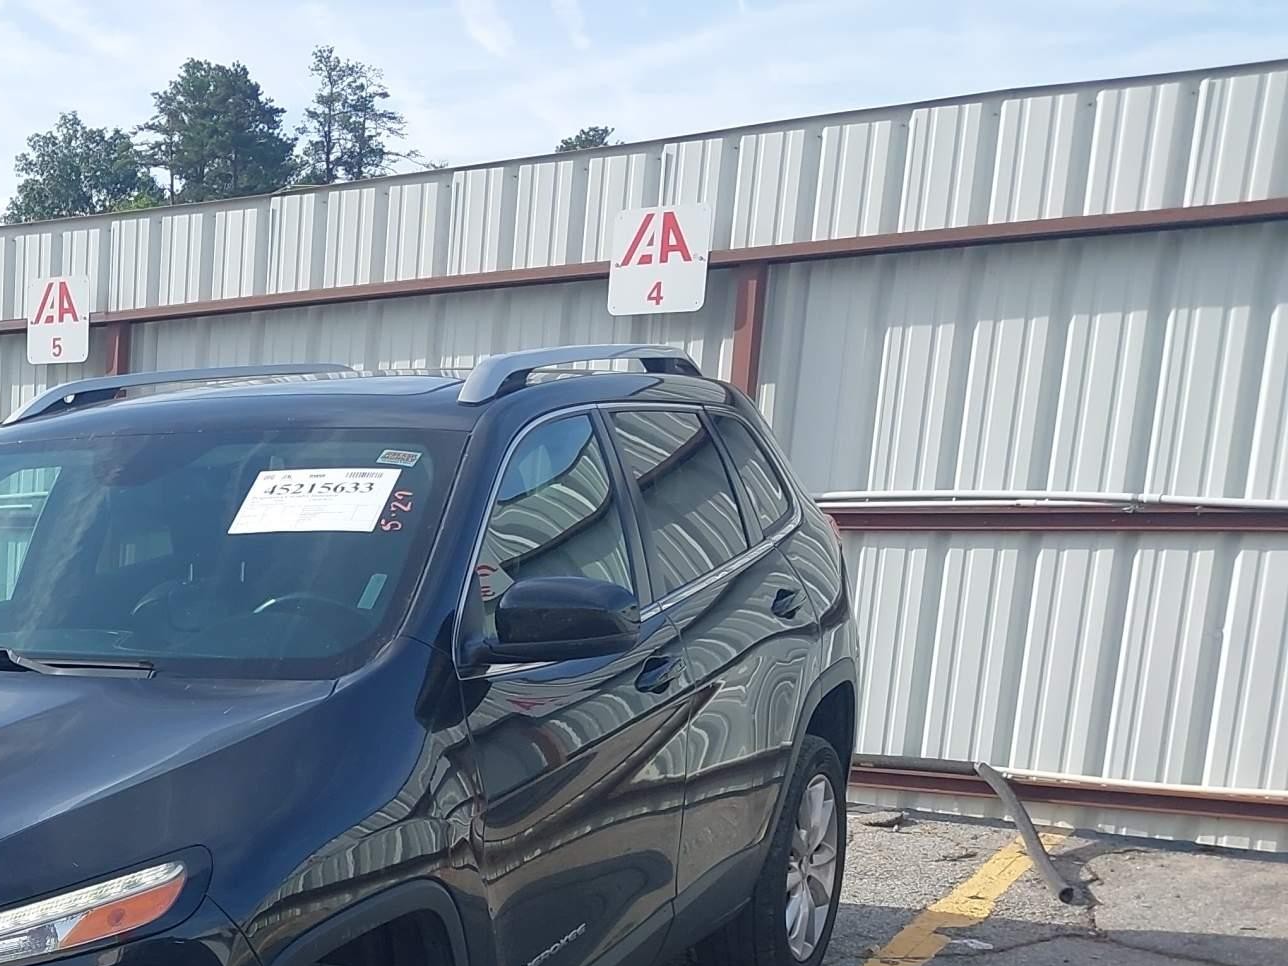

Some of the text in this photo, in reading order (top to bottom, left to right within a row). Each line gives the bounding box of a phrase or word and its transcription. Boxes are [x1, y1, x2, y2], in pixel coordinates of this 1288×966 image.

[646, 281, 664, 306] 4
[52, 337, 63, 358] 5
[264, 482, 374, 495] 45215633
